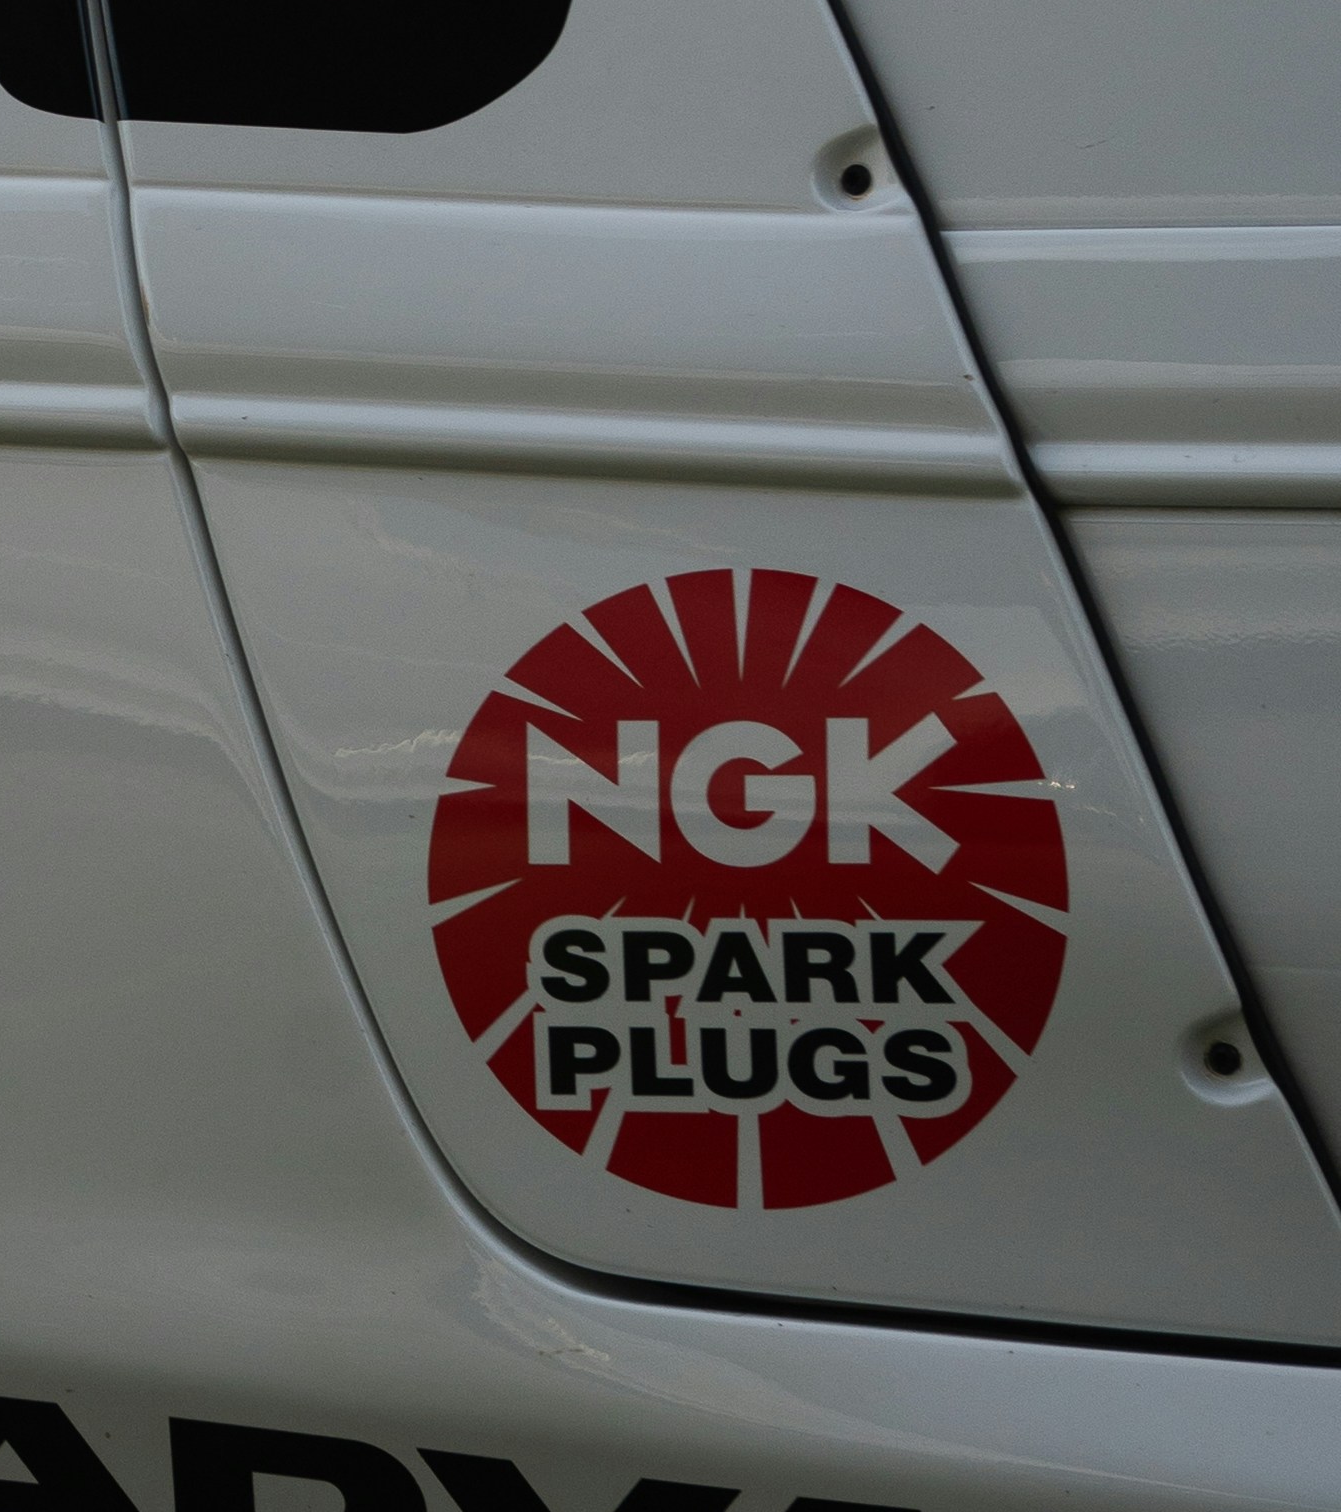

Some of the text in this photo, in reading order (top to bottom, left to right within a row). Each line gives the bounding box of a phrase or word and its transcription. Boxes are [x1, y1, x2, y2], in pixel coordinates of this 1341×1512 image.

[525, 711, 962, 876] NGK
[540, 928, 957, 1005] SPARK
[546, 1024, 960, 1102] PLUGS
